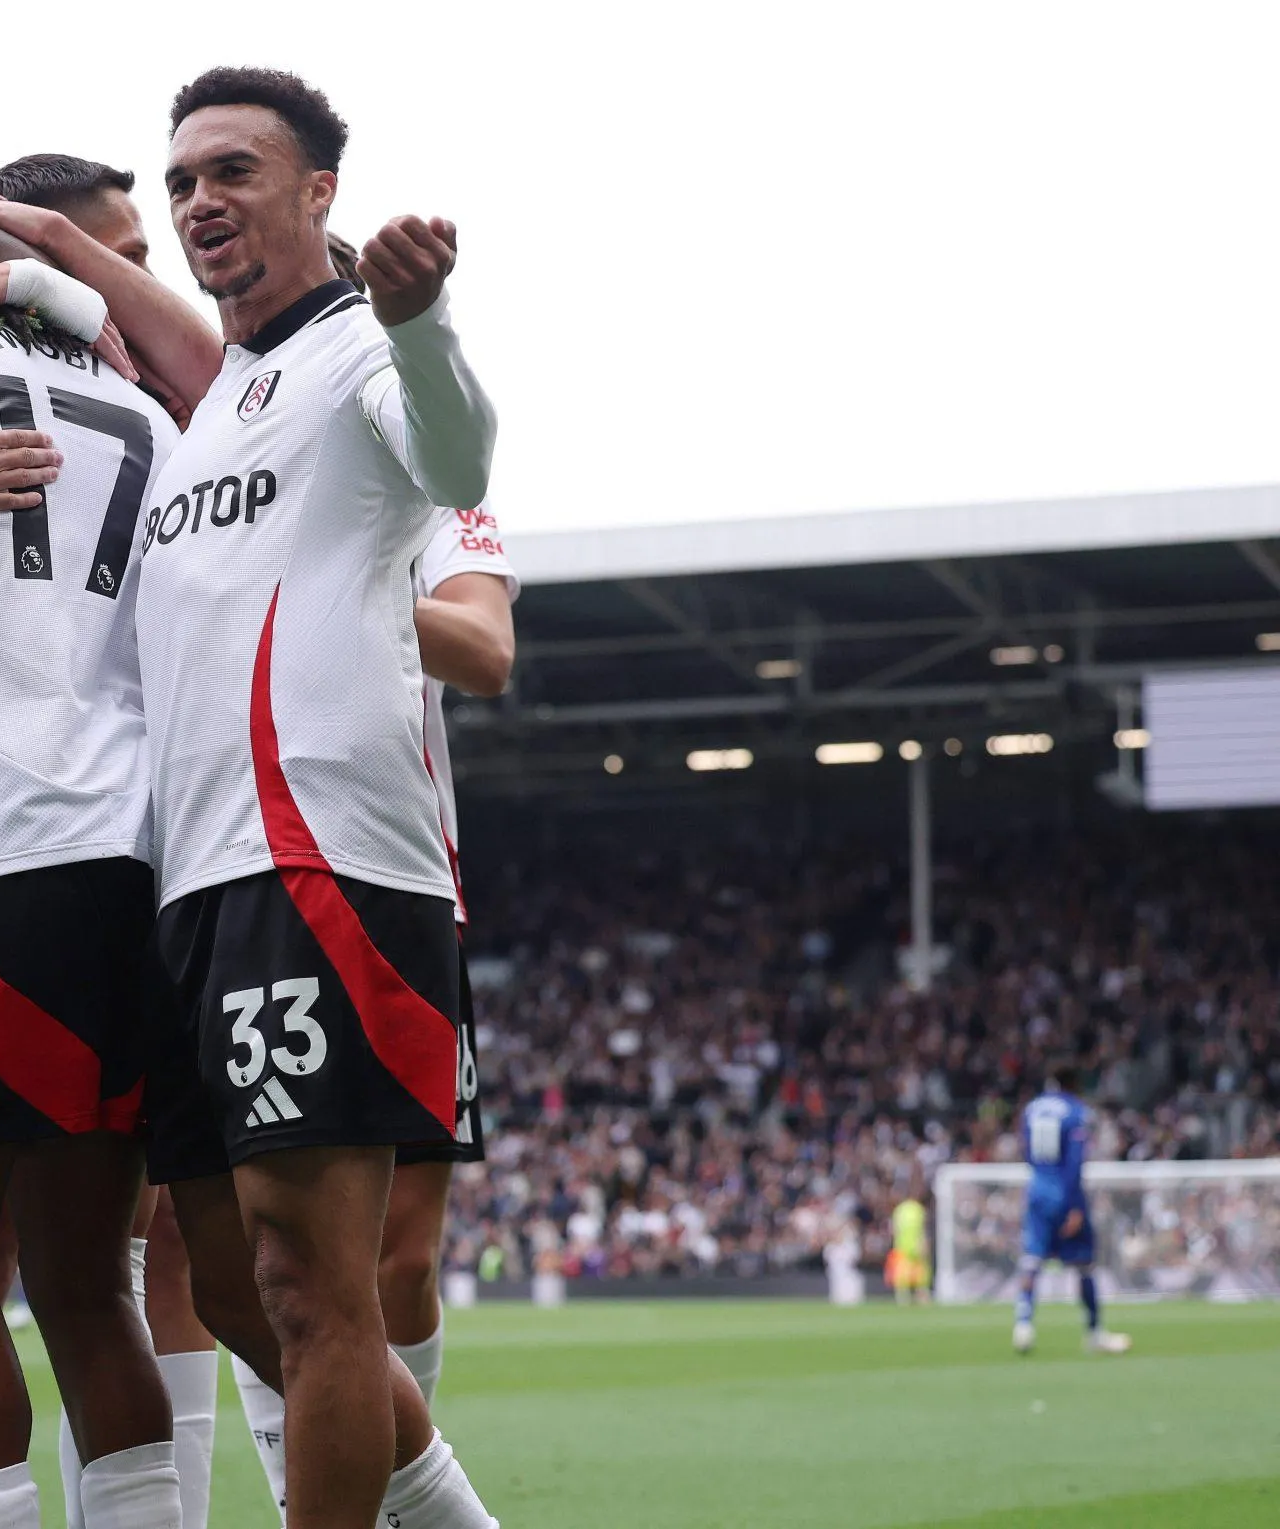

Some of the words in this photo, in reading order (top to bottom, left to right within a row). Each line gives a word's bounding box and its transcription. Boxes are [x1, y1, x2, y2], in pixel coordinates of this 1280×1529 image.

[141, 469, 278, 558] BOTOP
[222, 976, 328, 1088] 33
[455, 1023, 478, 1102] 6
